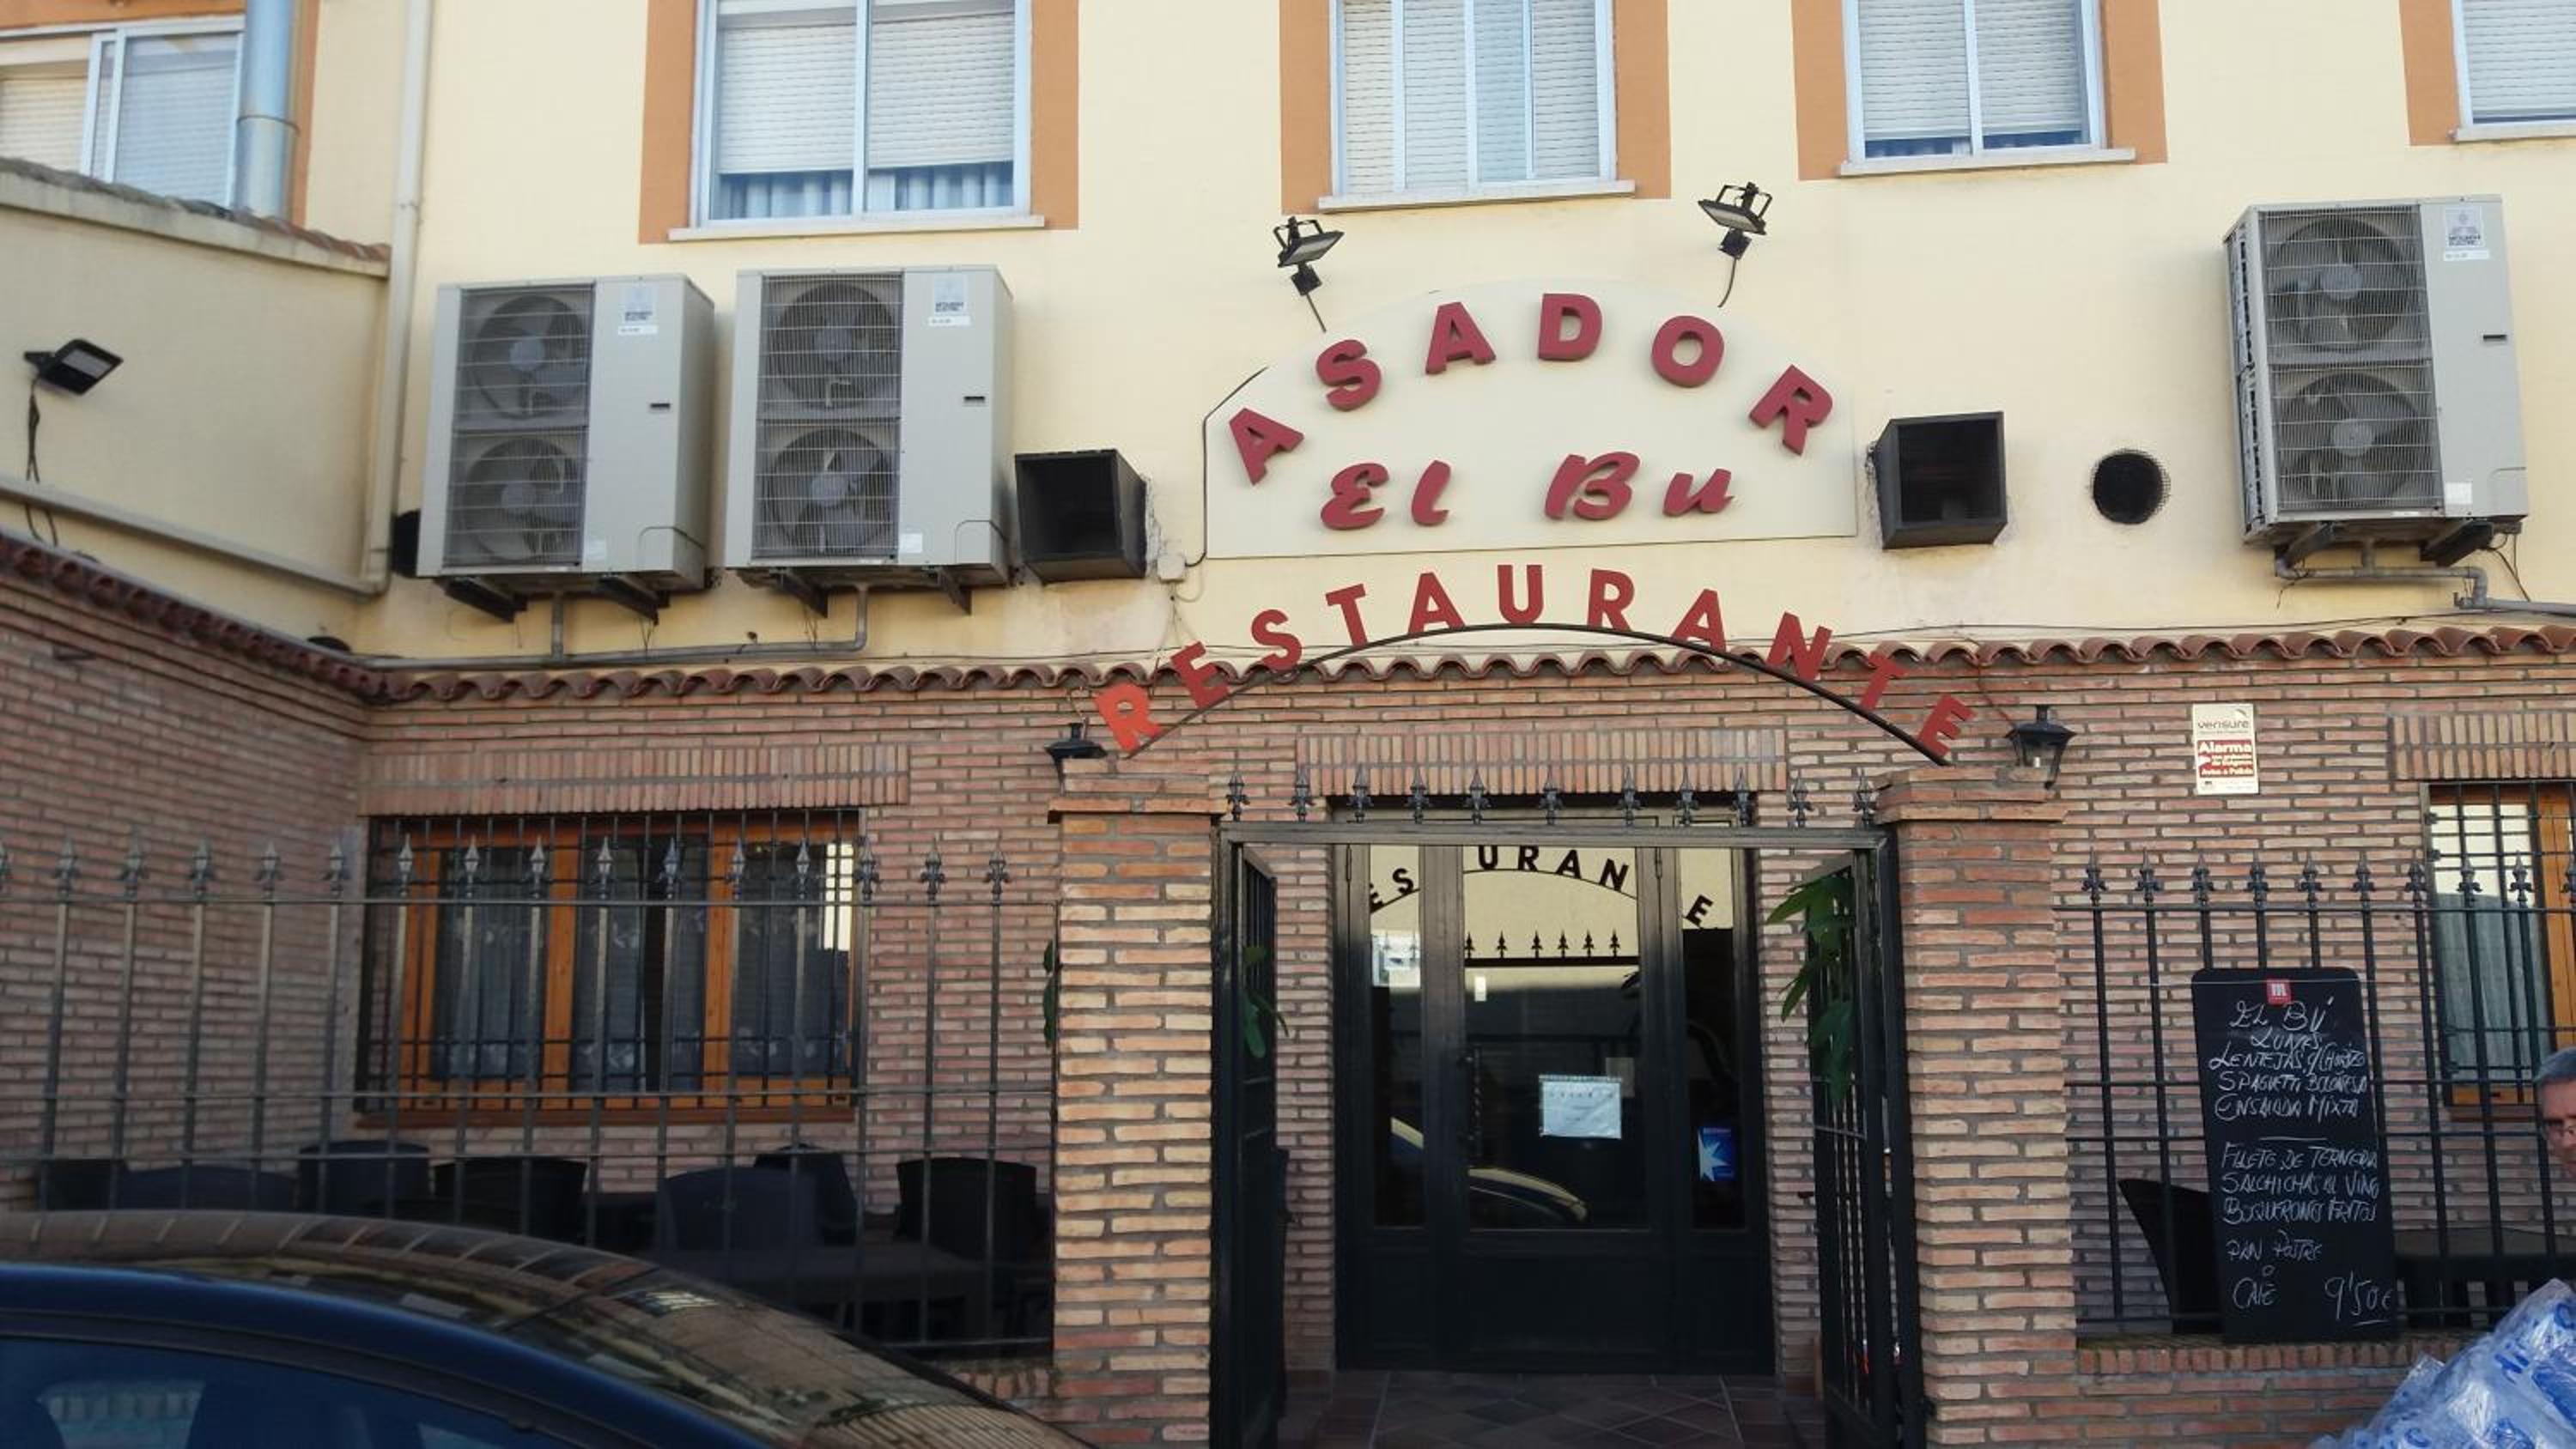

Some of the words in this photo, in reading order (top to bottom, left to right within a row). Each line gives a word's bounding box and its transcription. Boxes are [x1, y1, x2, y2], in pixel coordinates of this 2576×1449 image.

[1229, 293, 1833, 486] ASADOR
[1321, 460, 1452, 530] El
[1545, 451, 1735, 521] Bu
[1097, 564, 1977, 760] RESTAURANTE
